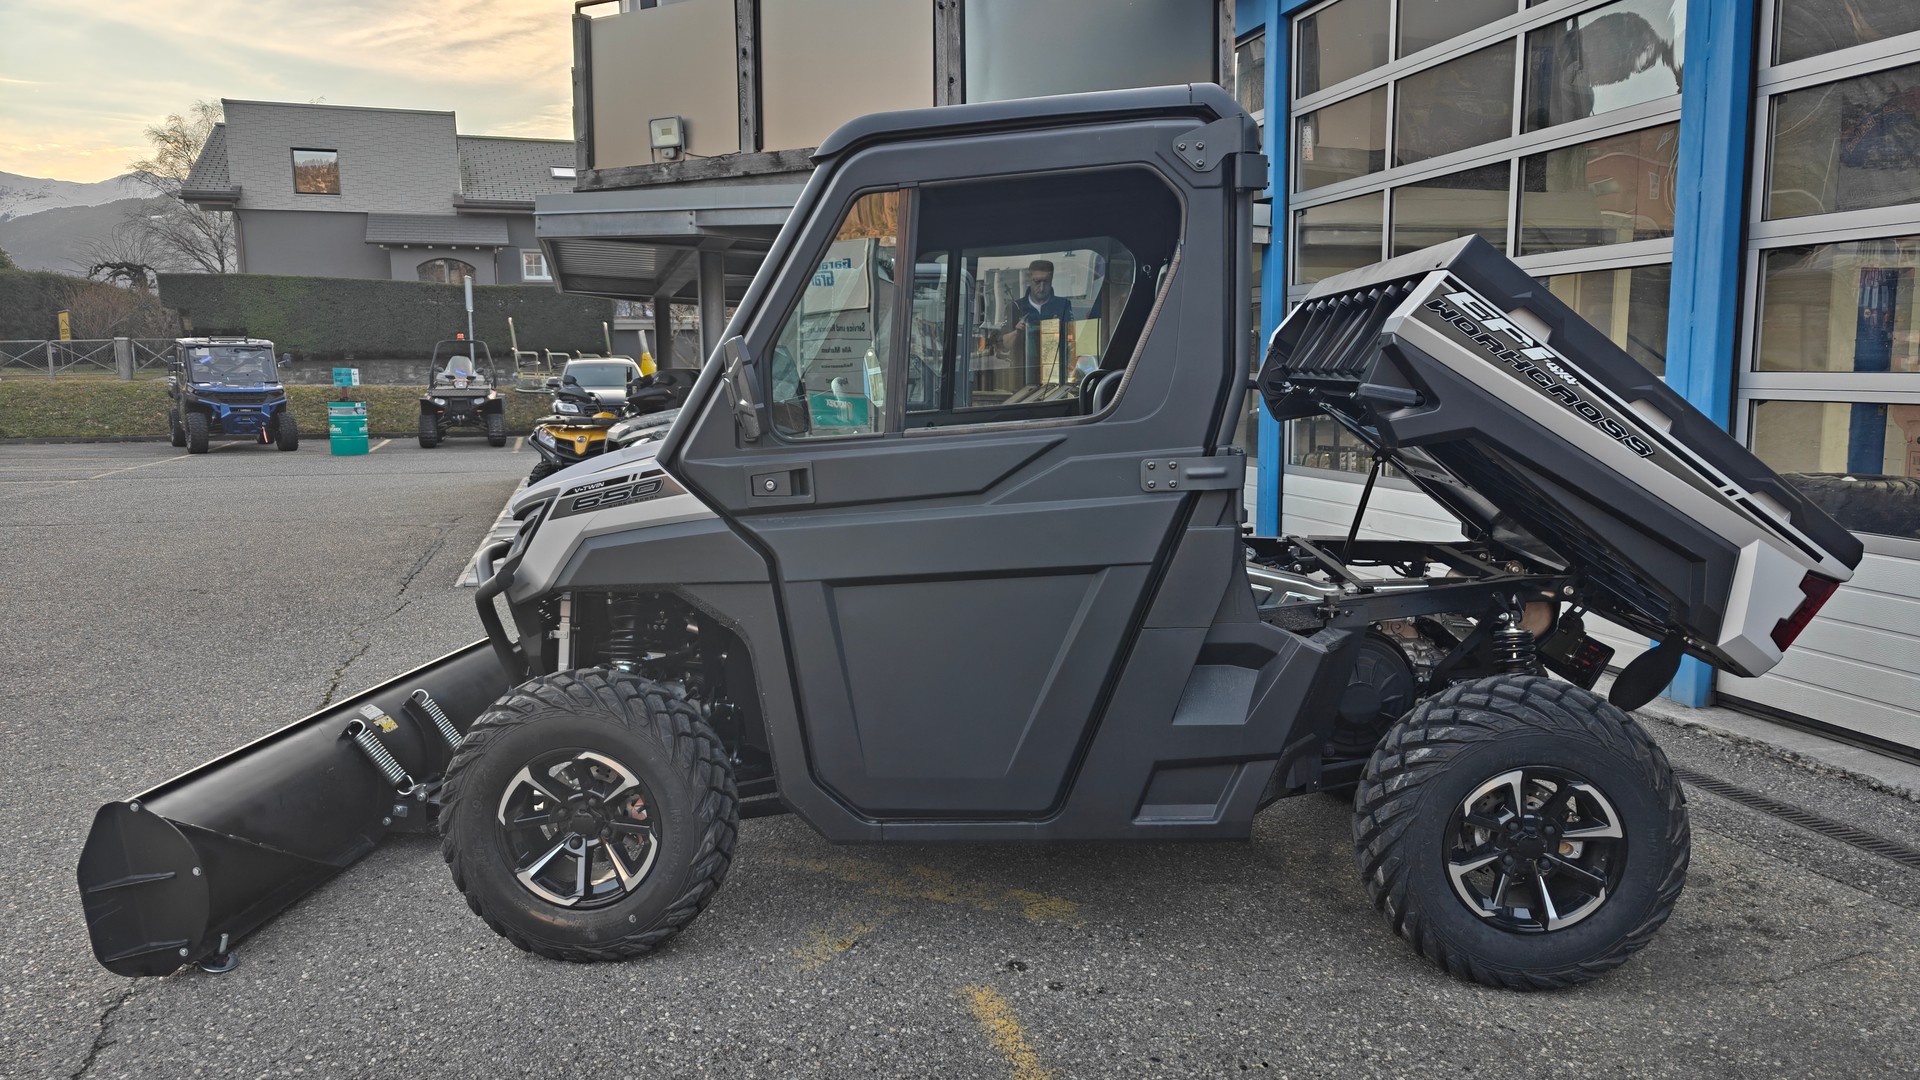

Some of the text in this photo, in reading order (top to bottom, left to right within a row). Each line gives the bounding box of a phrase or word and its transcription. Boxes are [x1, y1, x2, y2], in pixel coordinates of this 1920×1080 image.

[1444, 291, 1556, 361] EFI
[571, 478, 665, 512] 650
[574, 481, 605, 494] V-TWIN
